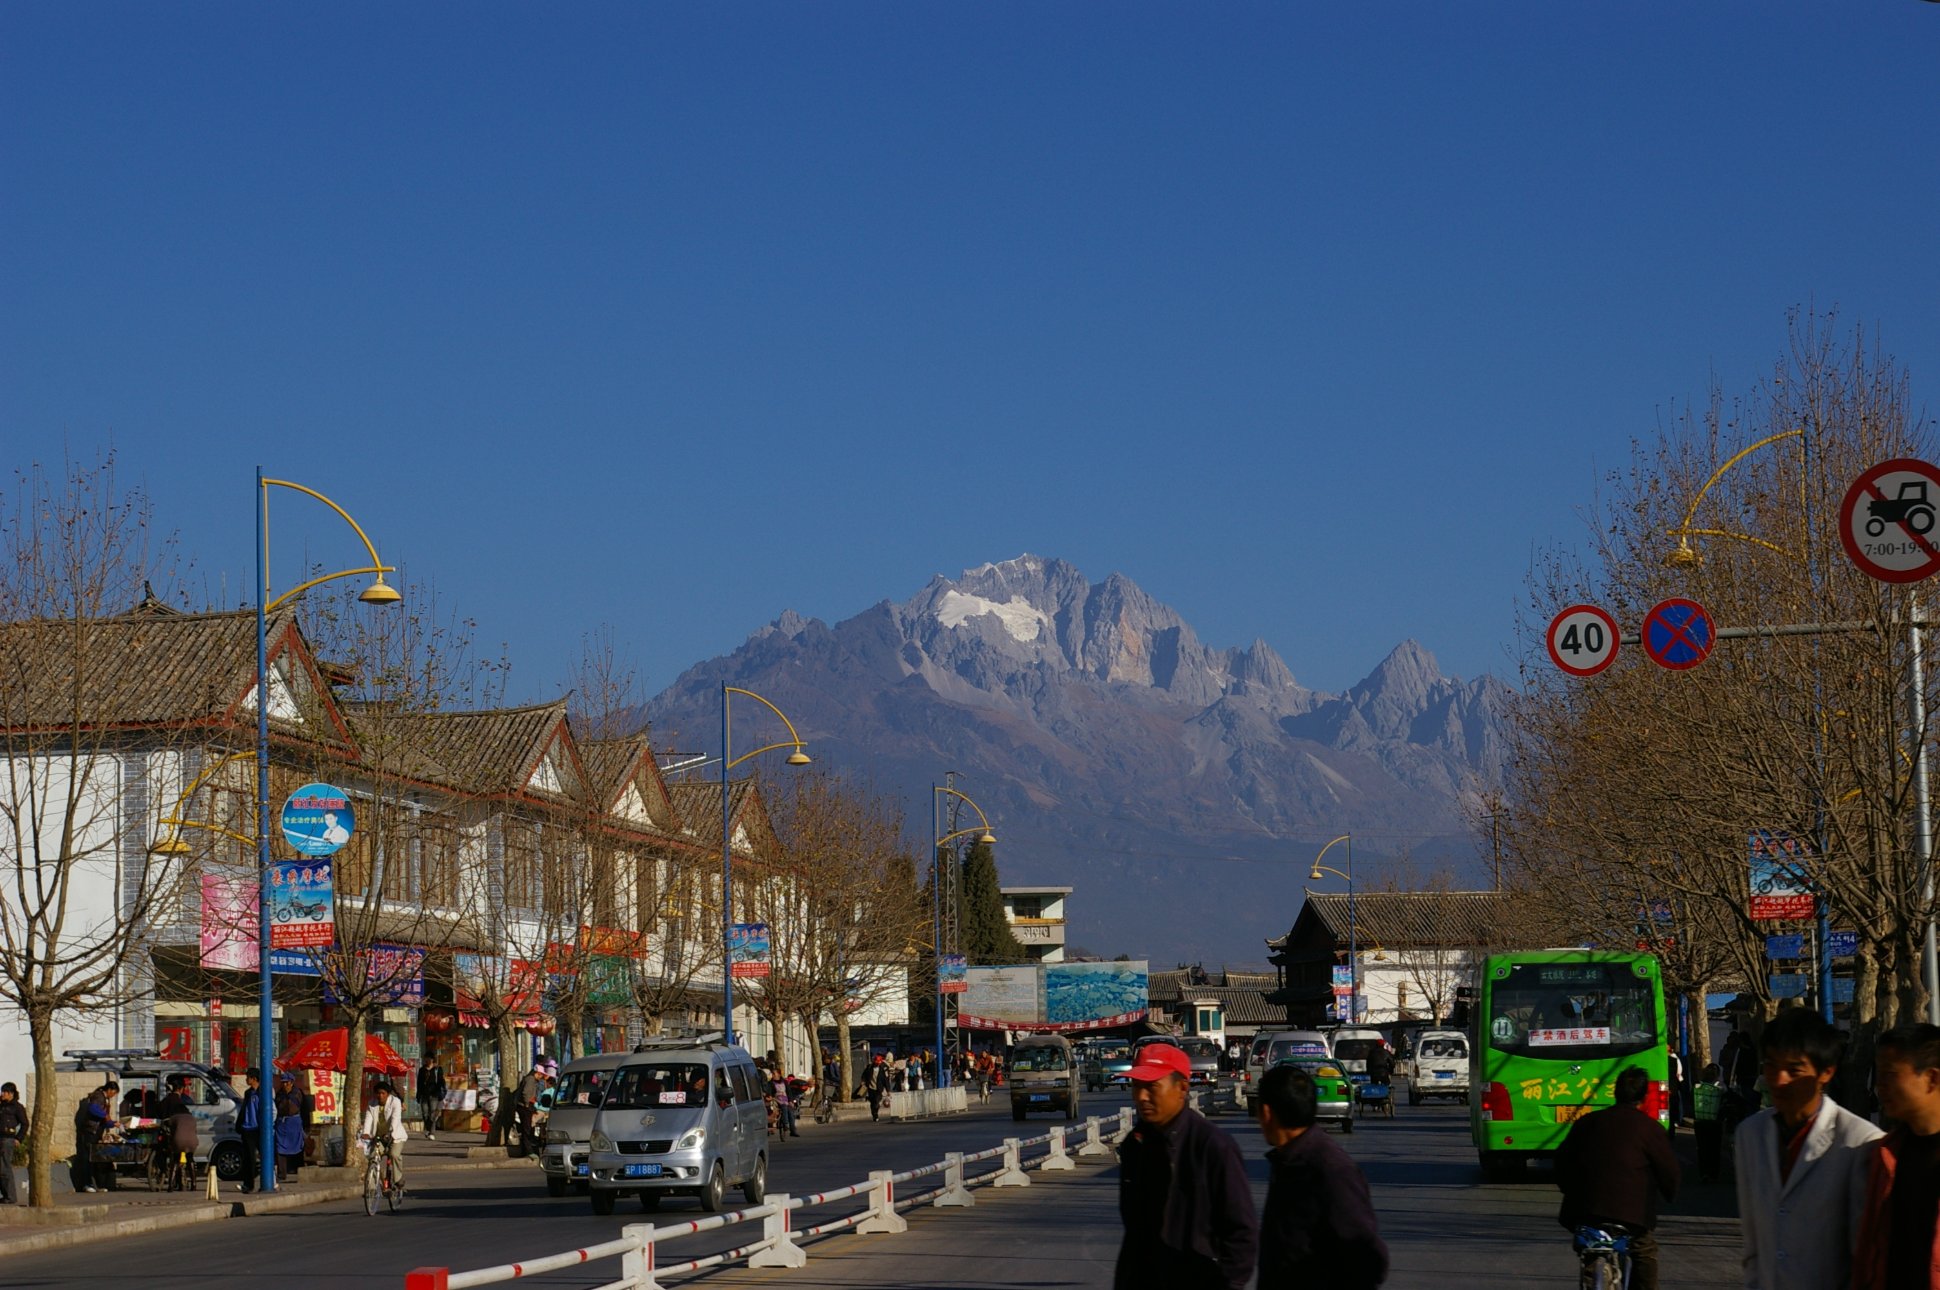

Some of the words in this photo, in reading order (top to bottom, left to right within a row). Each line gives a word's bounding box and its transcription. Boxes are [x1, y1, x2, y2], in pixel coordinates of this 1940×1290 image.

[1561, 622, 1604, 655] 40
[1498, 1021, 1508, 1036] 11
[1529, 1029, 1607, 1042] 严禁酒后驾车
